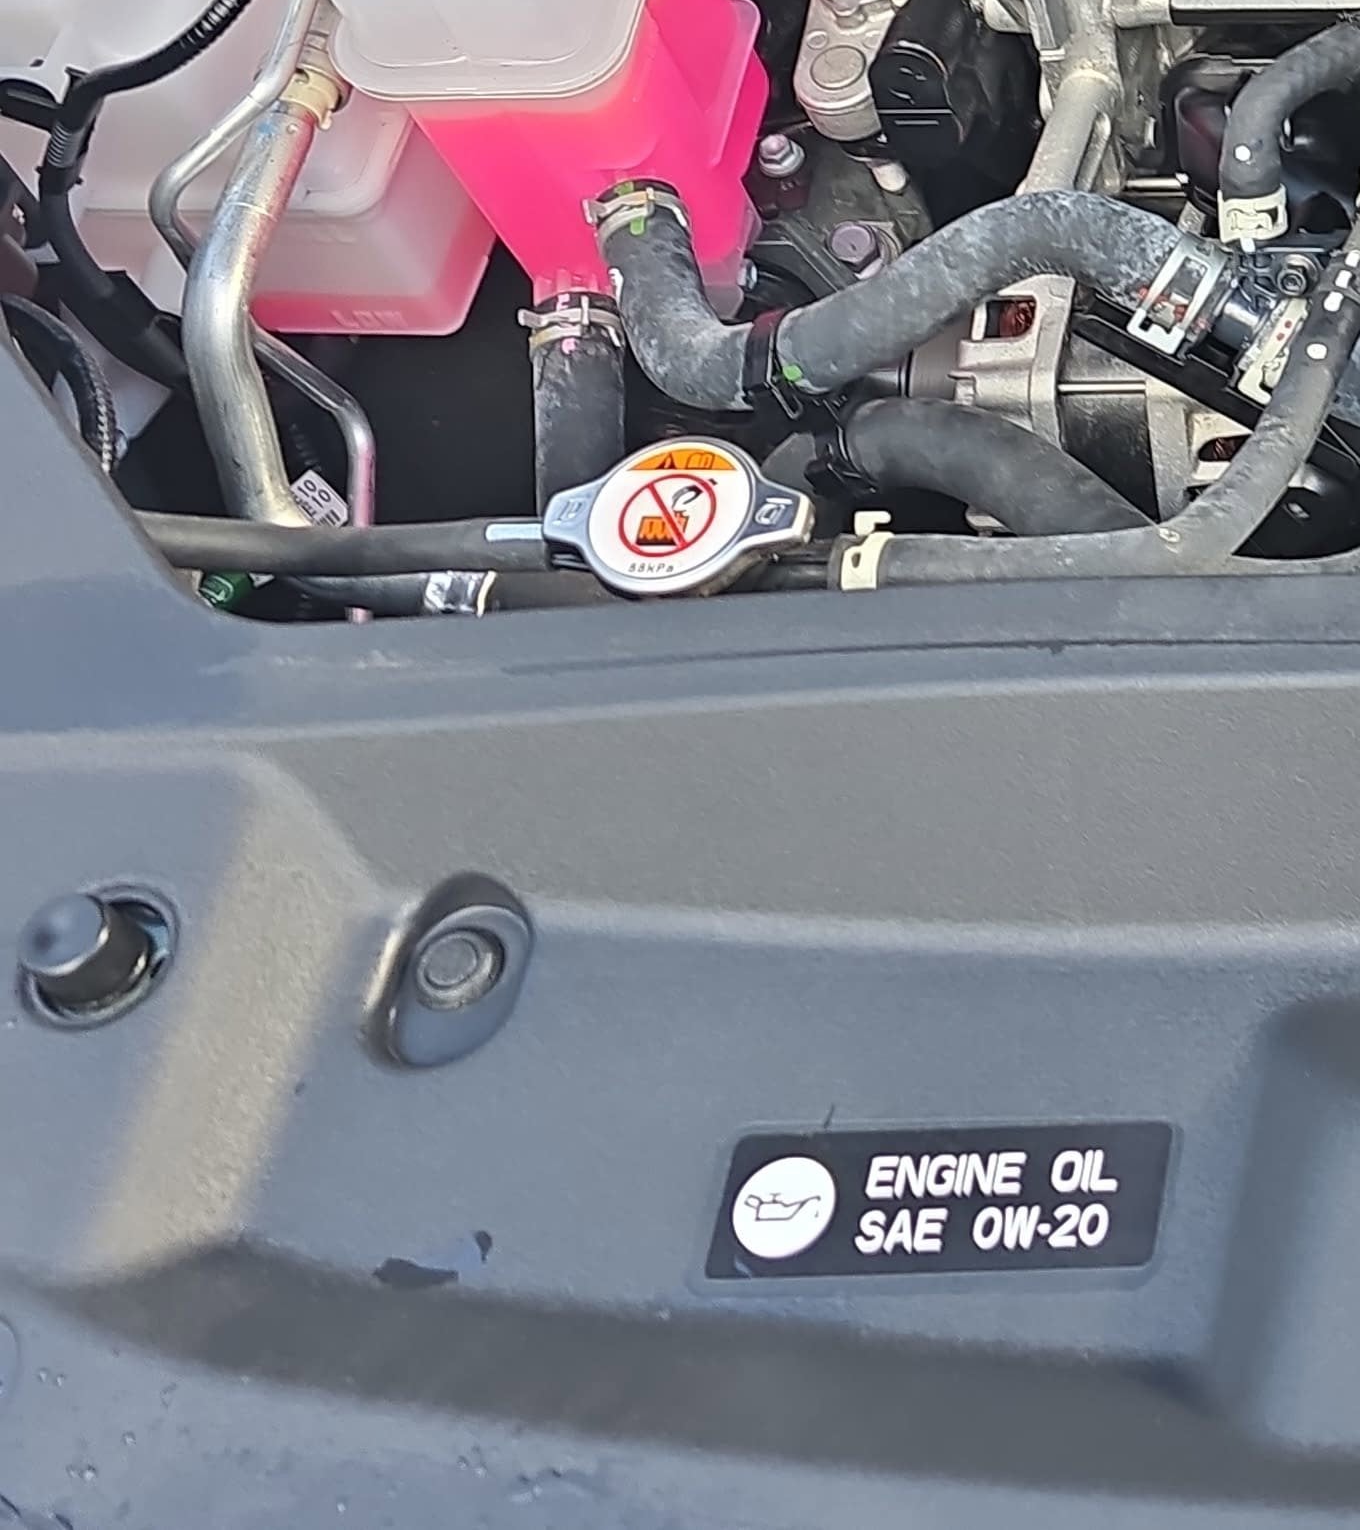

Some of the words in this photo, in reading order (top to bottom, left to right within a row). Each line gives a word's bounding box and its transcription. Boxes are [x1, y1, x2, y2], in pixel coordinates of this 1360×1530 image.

[864, 1151, 1027, 1199] ENGINE
[1051, 1149, 1118, 1193] OIL
[854, 1207, 948, 1254] SAE
[972, 1203, 1109, 1250] 0W-20
